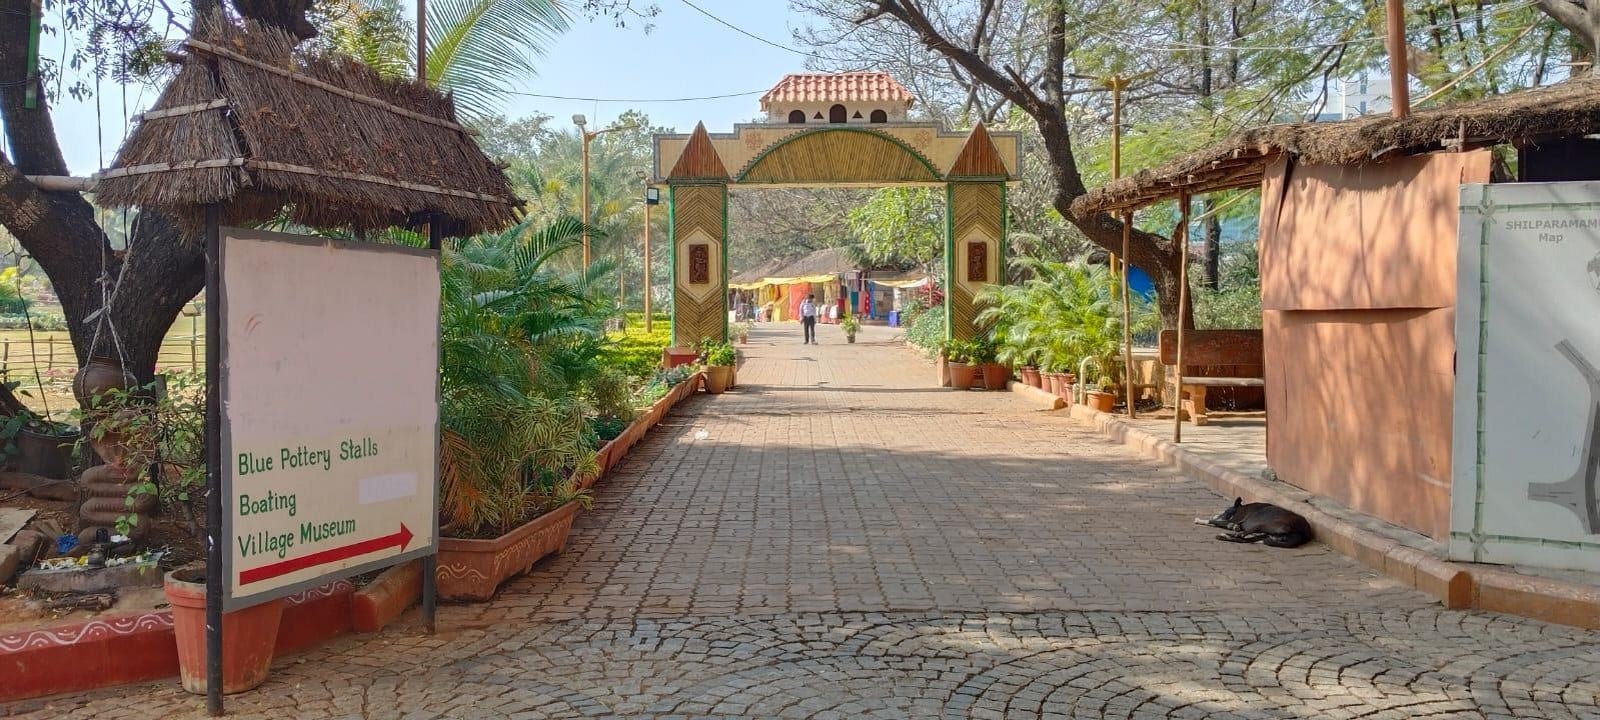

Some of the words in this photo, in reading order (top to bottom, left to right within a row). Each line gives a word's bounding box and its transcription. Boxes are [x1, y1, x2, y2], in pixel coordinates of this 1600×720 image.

[1538, 232, 1564, 244] Map
[239, 453, 273, 475] Blue
[280, 446, 331, 470] Pottery
[339, 437, 378, 460] Stalls
[239, 490, 296, 516] Boating
[238, 531, 294, 558] Village
[300, 518, 356, 544] Museum
